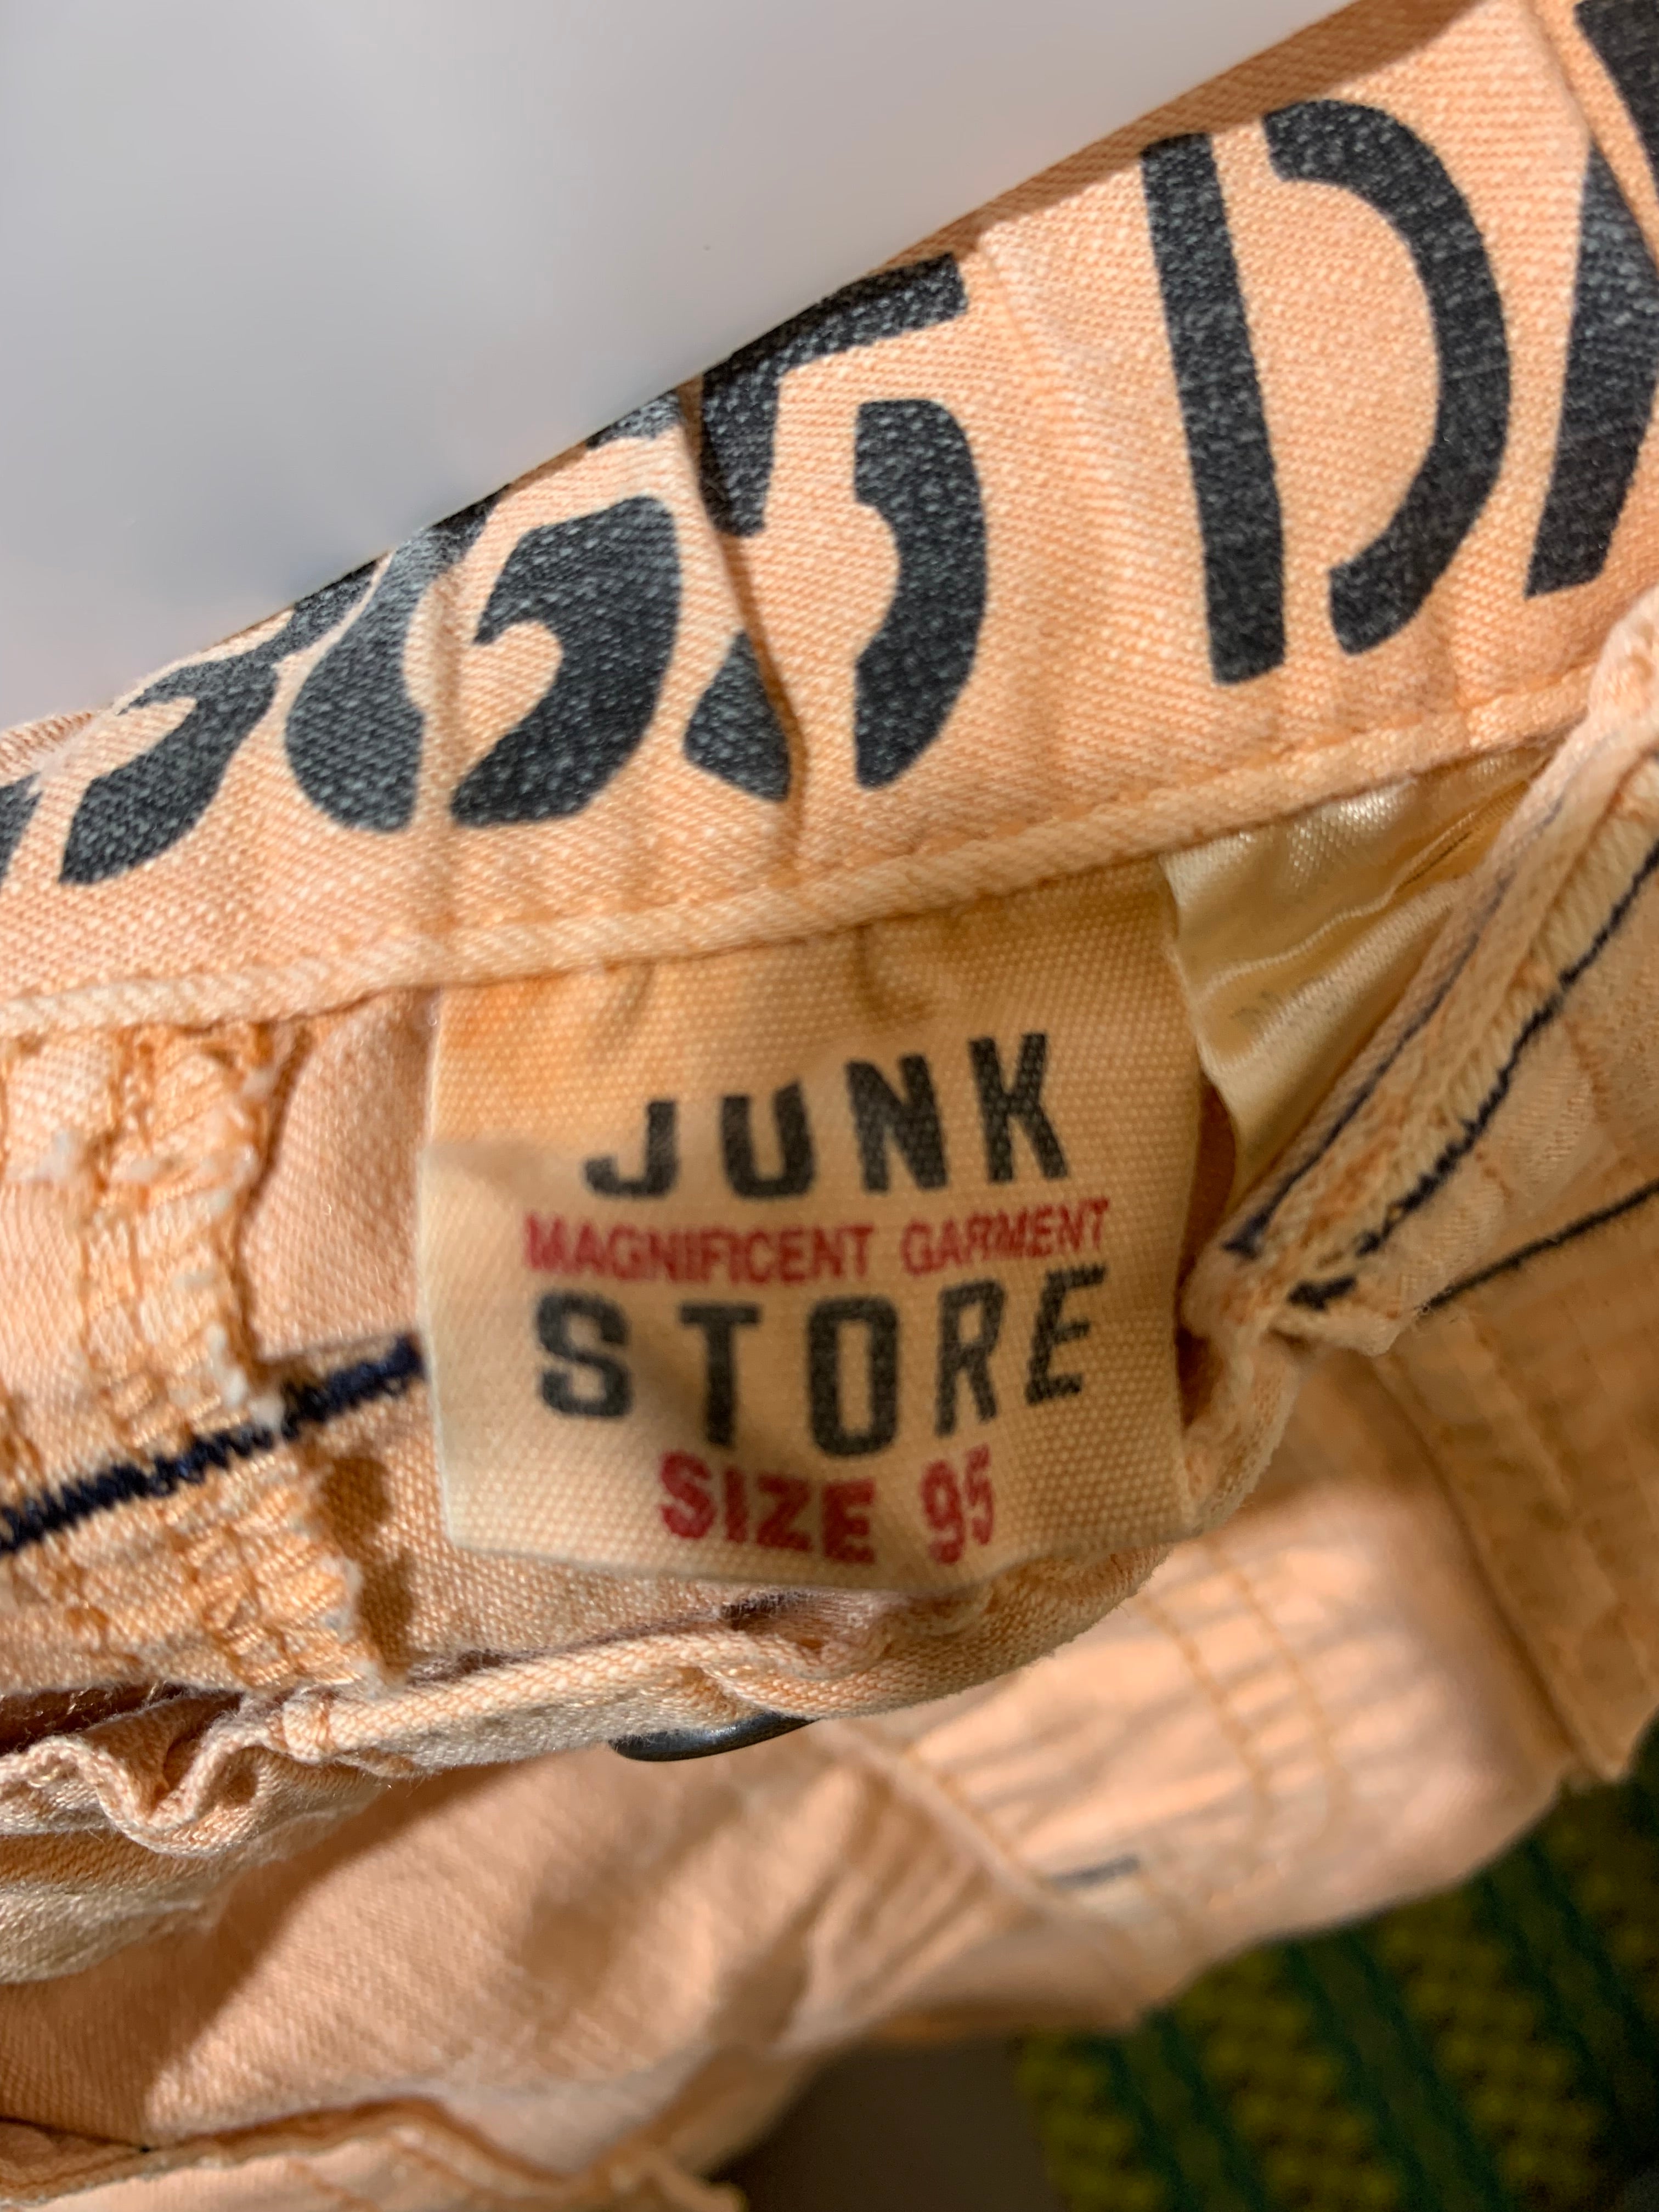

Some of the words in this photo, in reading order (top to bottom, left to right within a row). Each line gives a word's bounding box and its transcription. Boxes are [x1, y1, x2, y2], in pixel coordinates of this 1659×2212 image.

[583, 1031, 1070, 1200] JUNK
[523, 1211, 874, 1286] MAGNIFICENT
[900, 1198, 1109, 1278] GARMENT
[533, 1264, 1107, 1459] STORE
[657, 1448, 877, 1565] SIZE
[919, 1442, 995, 1565] 95
